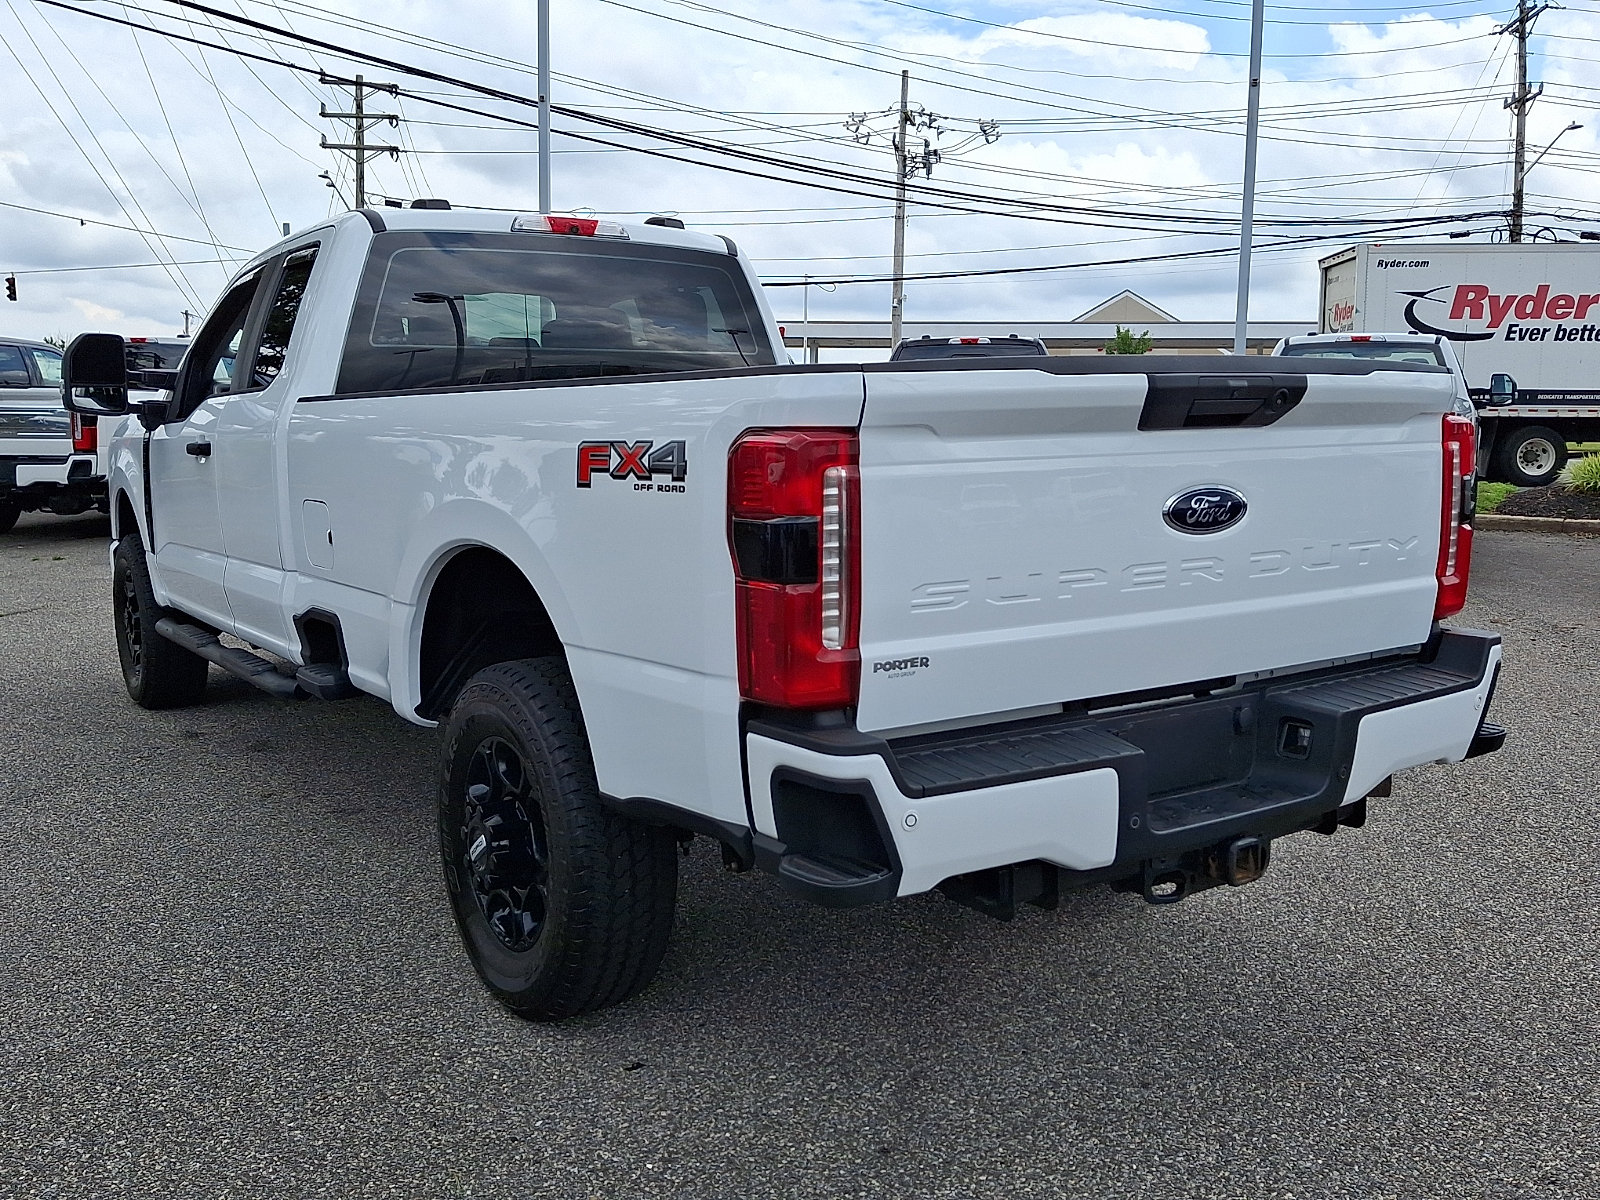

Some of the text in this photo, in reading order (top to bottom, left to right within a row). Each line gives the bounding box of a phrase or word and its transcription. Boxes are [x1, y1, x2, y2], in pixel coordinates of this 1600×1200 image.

[1376, 258, 1430, 270] Ryder.com
[1449, 284, 1600, 328] Ryder
[1504, 323, 1551, 341] Ever
[576, 440, 688, 489] FX4
[633, 483, 686, 493] OFF ROAD
[1186, 495, 1232, 524] Ford
[911, 535, 1418, 614] SUPER DUTY
[873, 656, 930, 673] PORTER
